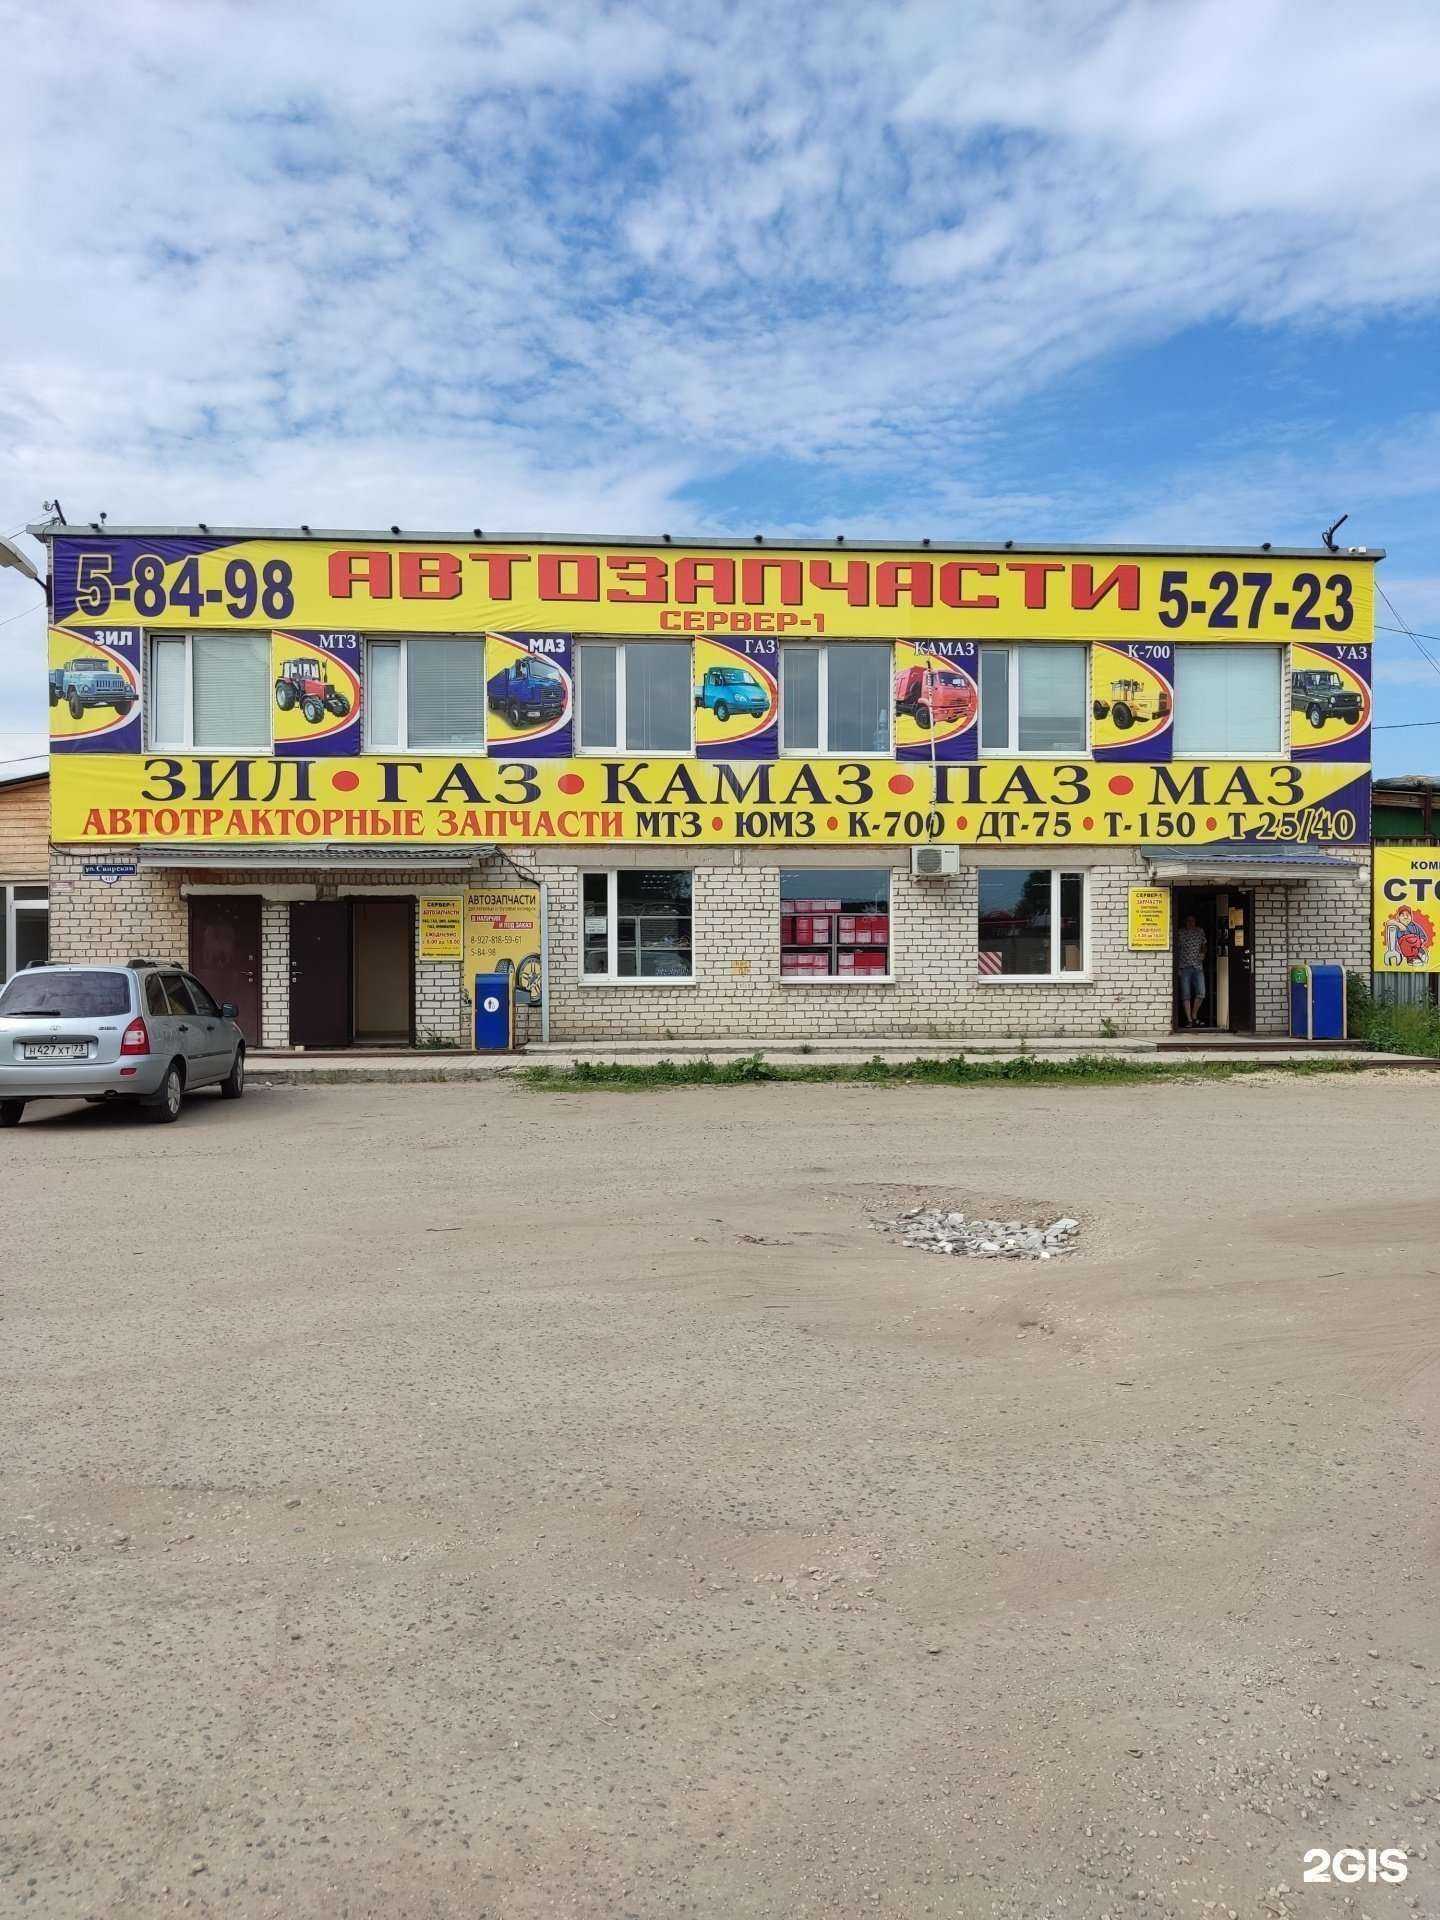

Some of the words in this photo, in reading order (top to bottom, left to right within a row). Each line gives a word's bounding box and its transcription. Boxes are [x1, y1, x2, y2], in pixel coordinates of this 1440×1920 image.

[75, 554, 295, 619] 5-84-98
[328, 551, 1140, 611] АВТОЗАПЧАСТИ
[1158, 571, 1354, 632] 5-27-23
[660, 611, 825, 632] СЕРВЕР-1
[94, 631, 133, 646] ЗИЛ
[319, 634, 357, 649] МТЗ
[529, 638, 566, 653] МАЗ
[744, 639, 776, 654] ГАЗ
[914, 641, 975, 656] КАМАЗ
[1127, 645, 1171, 659] К-700
[1336, 646, 1368, 660] УАЗ
[141, 759, 317, 801] ЗИЛ
[377, 762, 541, 804] ГАЗ
[601, 763, 873, 804] КАМАЗ
[929, 765, 1091, 804] ПАЗ
[1147, 765, 1304, 805] МАЗ
[82, 808, 424, 836] АВТОТРАКТОРНЫЕ
[437, 809, 623, 837] ЗАПЧАСТИ
[636, 811, 702, 838] МТЗ
[735, 811, 816, 838] ЮМЗ
[848, 811, 945, 838] К-700
[976, 811, 1072, 842] ДТ-75
[1104, 811, 1196, 838] Т-150
[1411, 861, 1440, 870] КОМ
[1384, 879, 1440, 901] СТ
[468, 894, 536, 905] АВТОЗАПЧАСТИ
